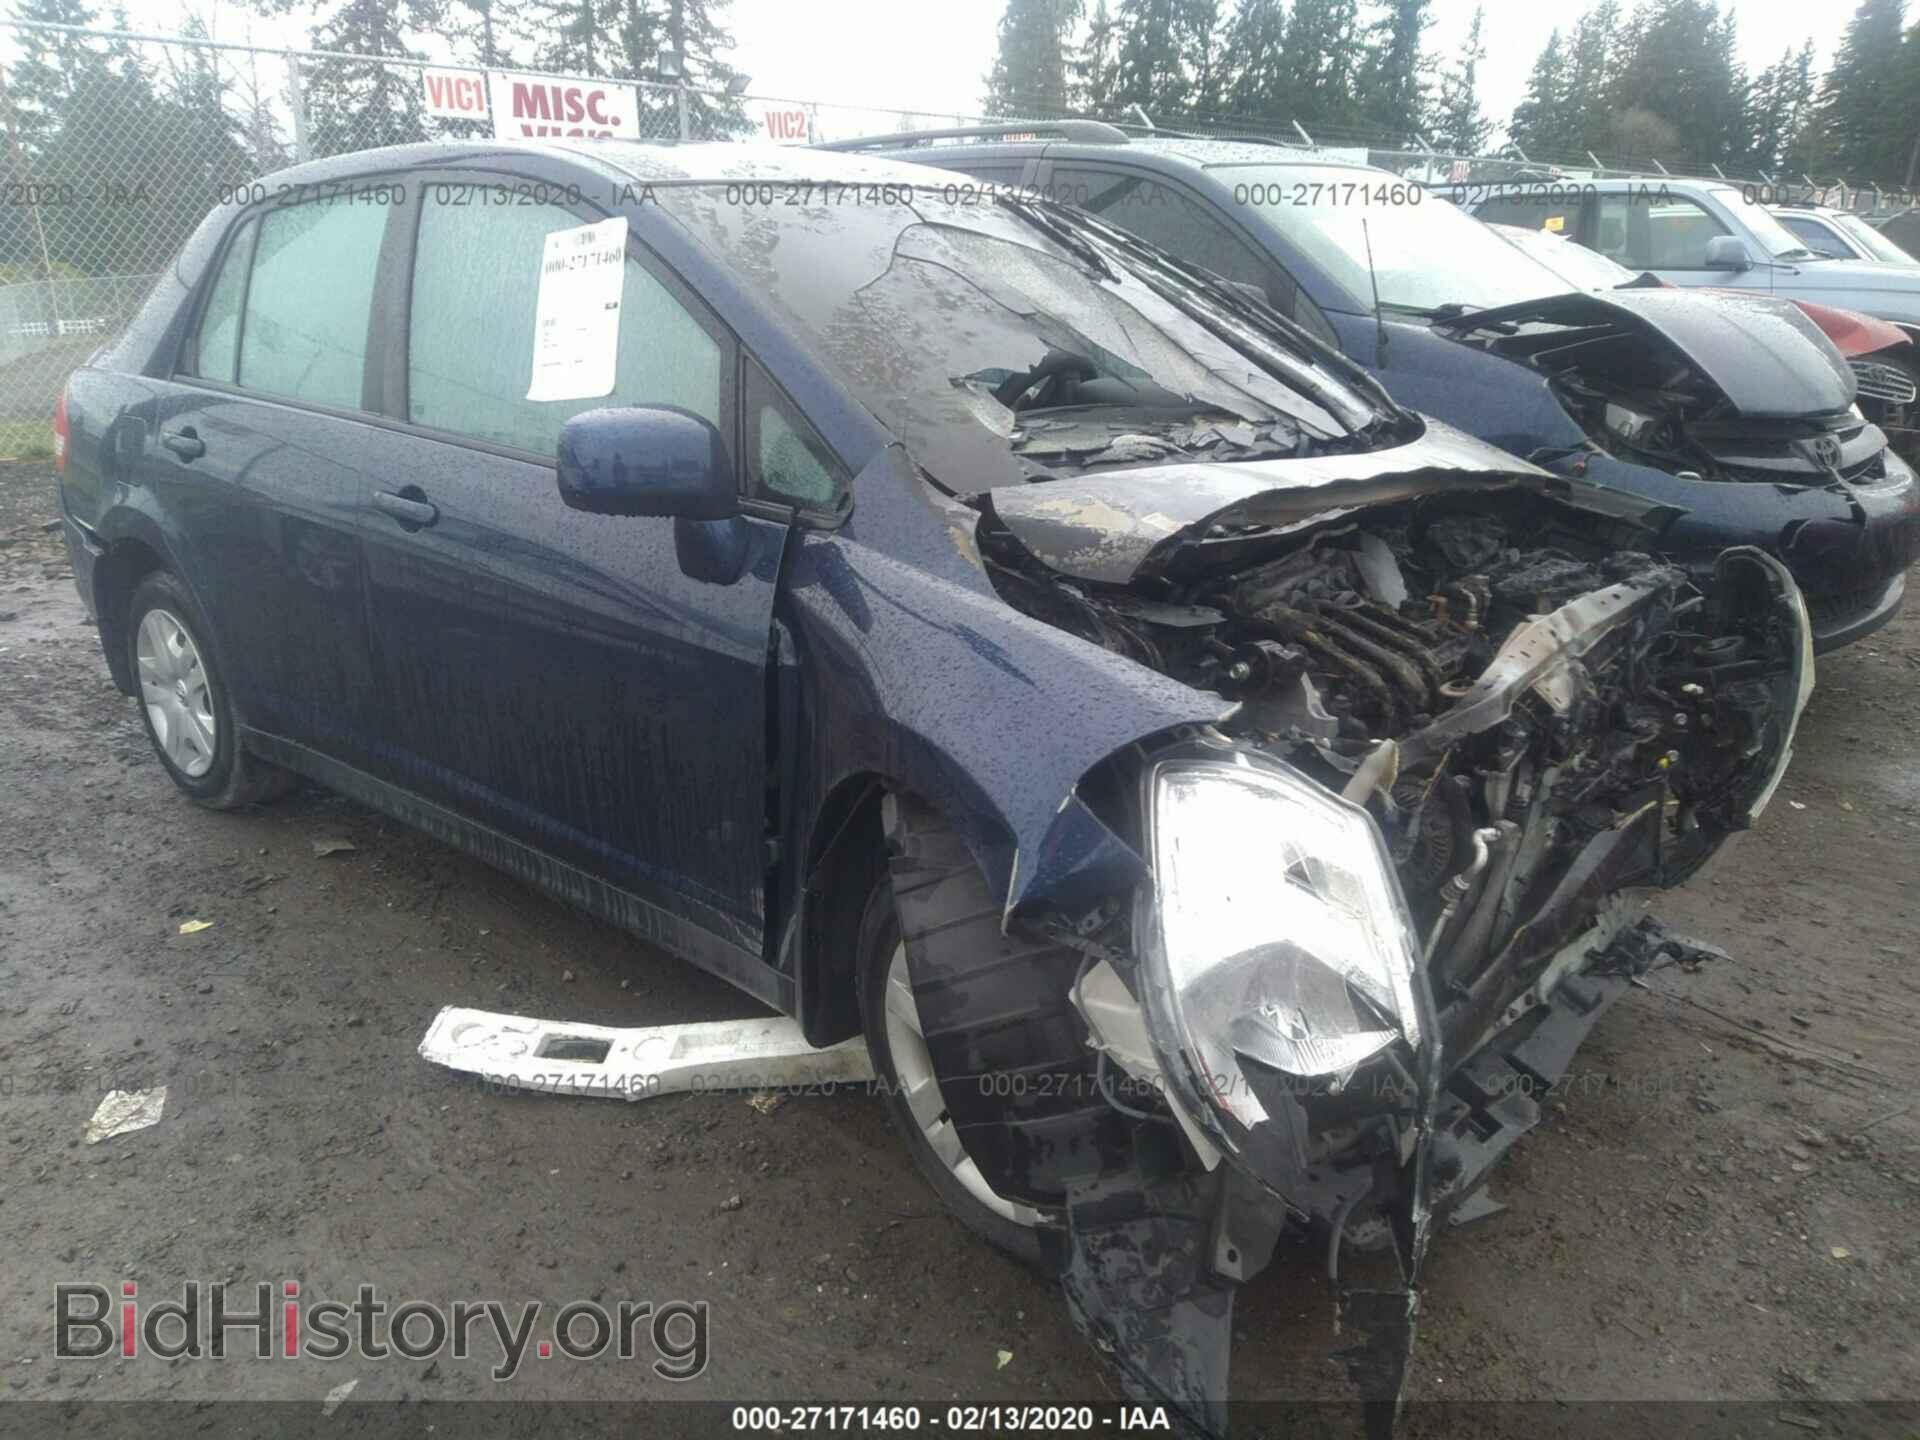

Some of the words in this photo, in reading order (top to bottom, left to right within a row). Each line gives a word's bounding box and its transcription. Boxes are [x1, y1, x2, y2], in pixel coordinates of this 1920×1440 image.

[425, 75, 485, 112] VIC1
[512, 82, 622, 127] MISC.
[765, 111, 807, 139] VIC2
